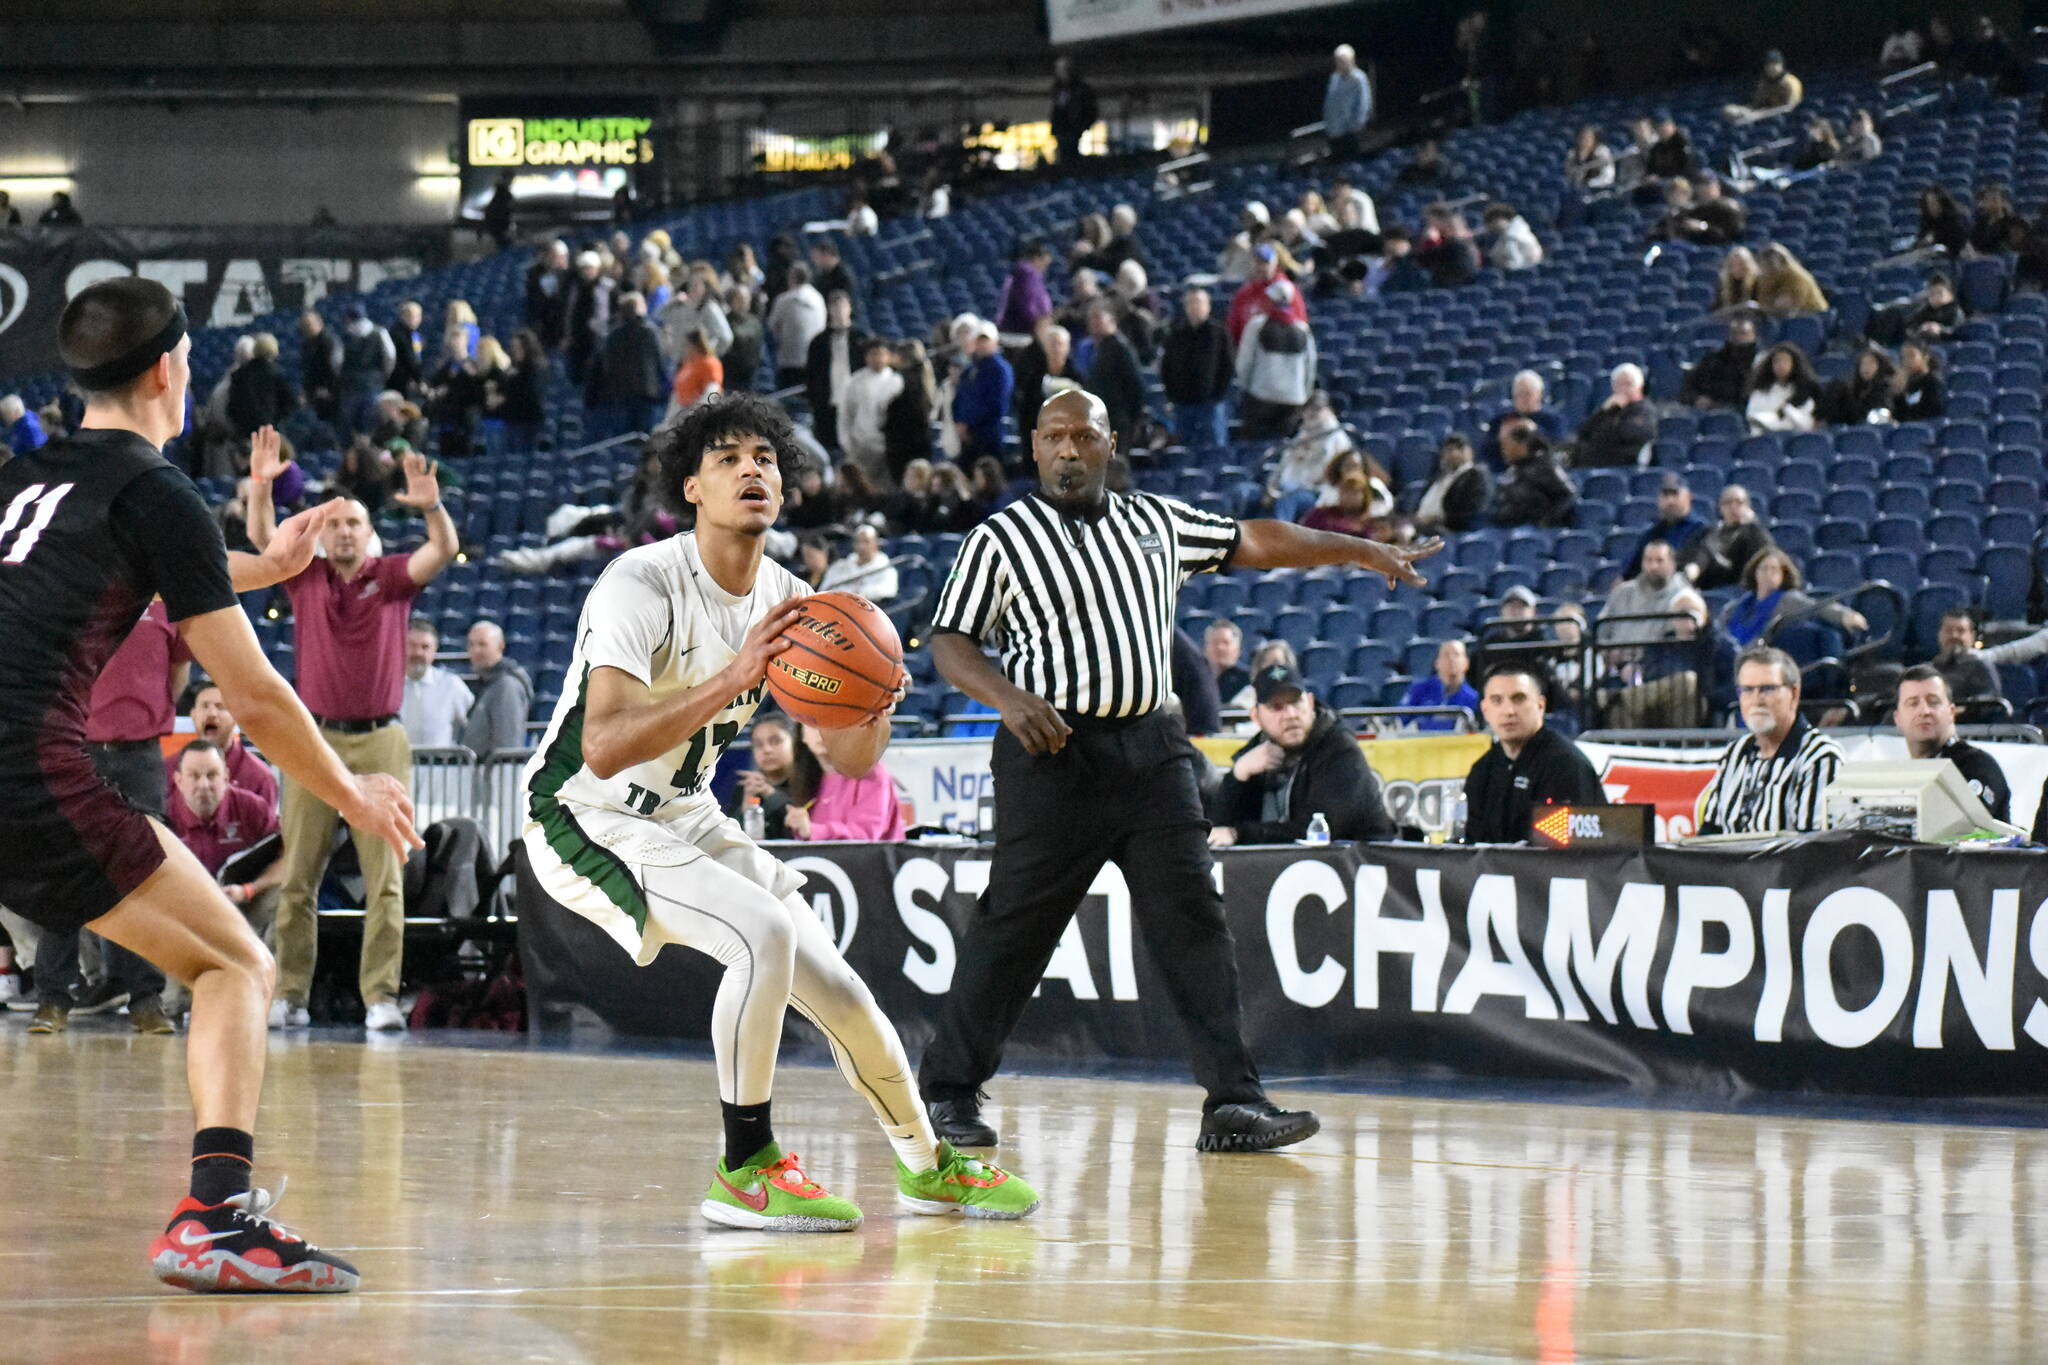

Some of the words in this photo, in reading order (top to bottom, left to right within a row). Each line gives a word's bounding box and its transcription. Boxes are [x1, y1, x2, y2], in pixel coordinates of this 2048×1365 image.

[525, 118, 652, 141] INDUSTRY
[525, 139, 654, 165] GRAPHICS
[0, 482, 76, 564] 11
[796, 606, 856, 651] aden
[806, 672, 841, 694] PRO
[1568, 814, 1603, 838] POSS.
